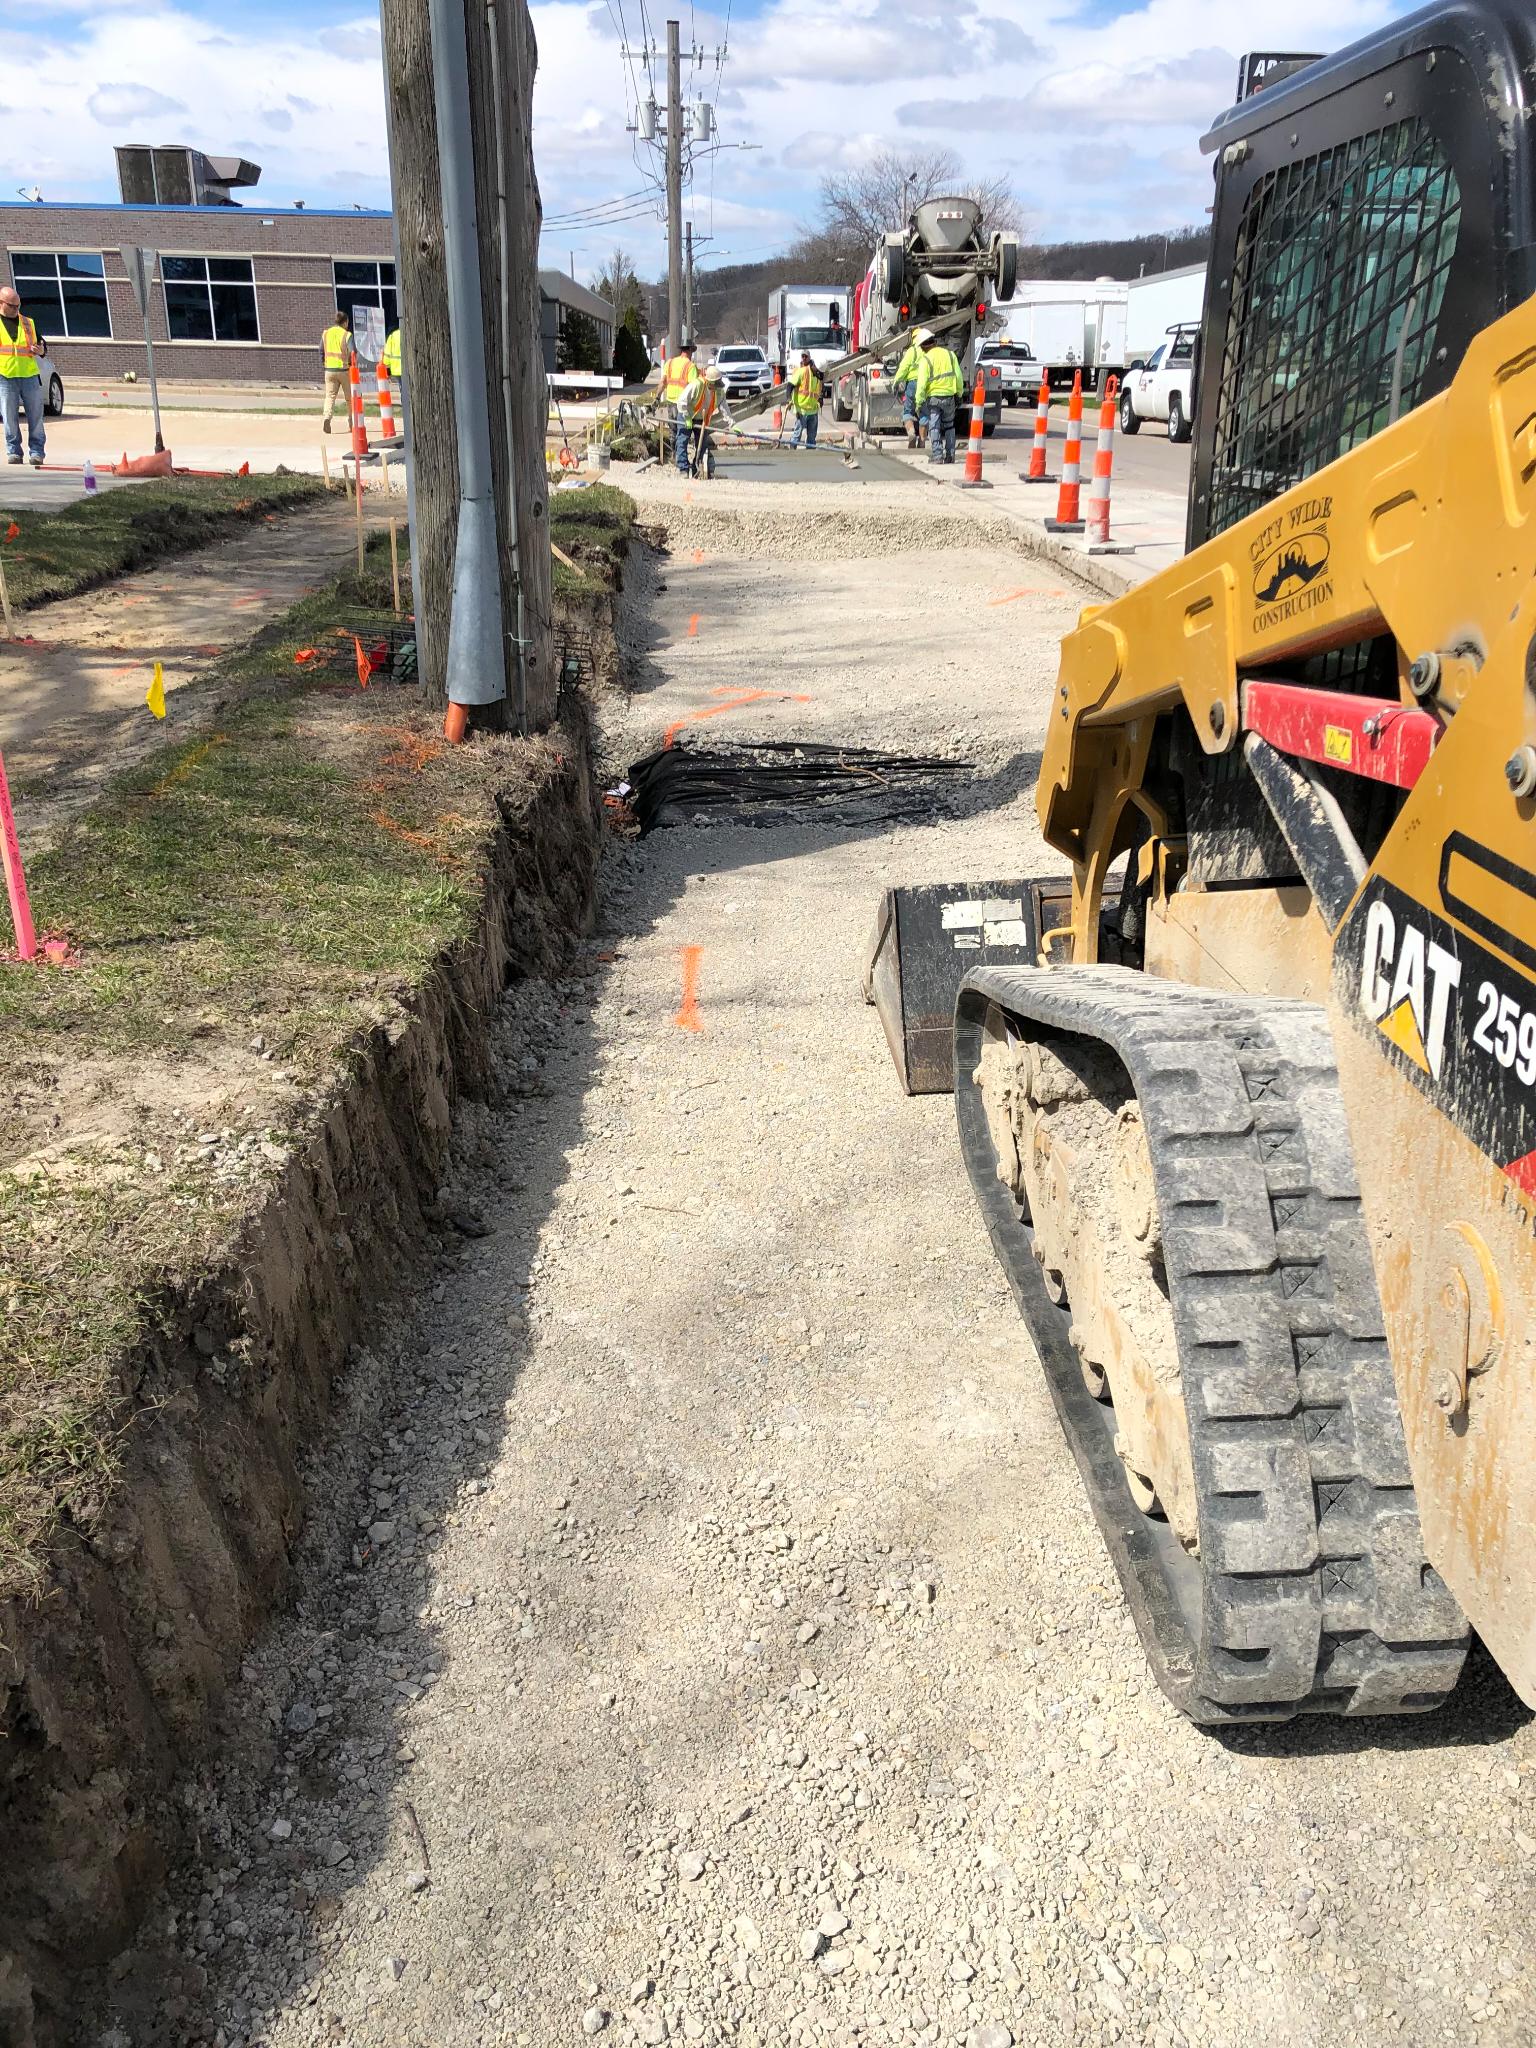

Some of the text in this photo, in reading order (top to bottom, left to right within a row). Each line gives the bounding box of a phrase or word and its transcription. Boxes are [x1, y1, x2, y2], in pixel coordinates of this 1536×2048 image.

[1249, 496, 1333, 562] CITY WIDE
[1253, 578, 1334, 633] CONSTRUCTION
[1360, 900, 1536, 1086] CAT 259
